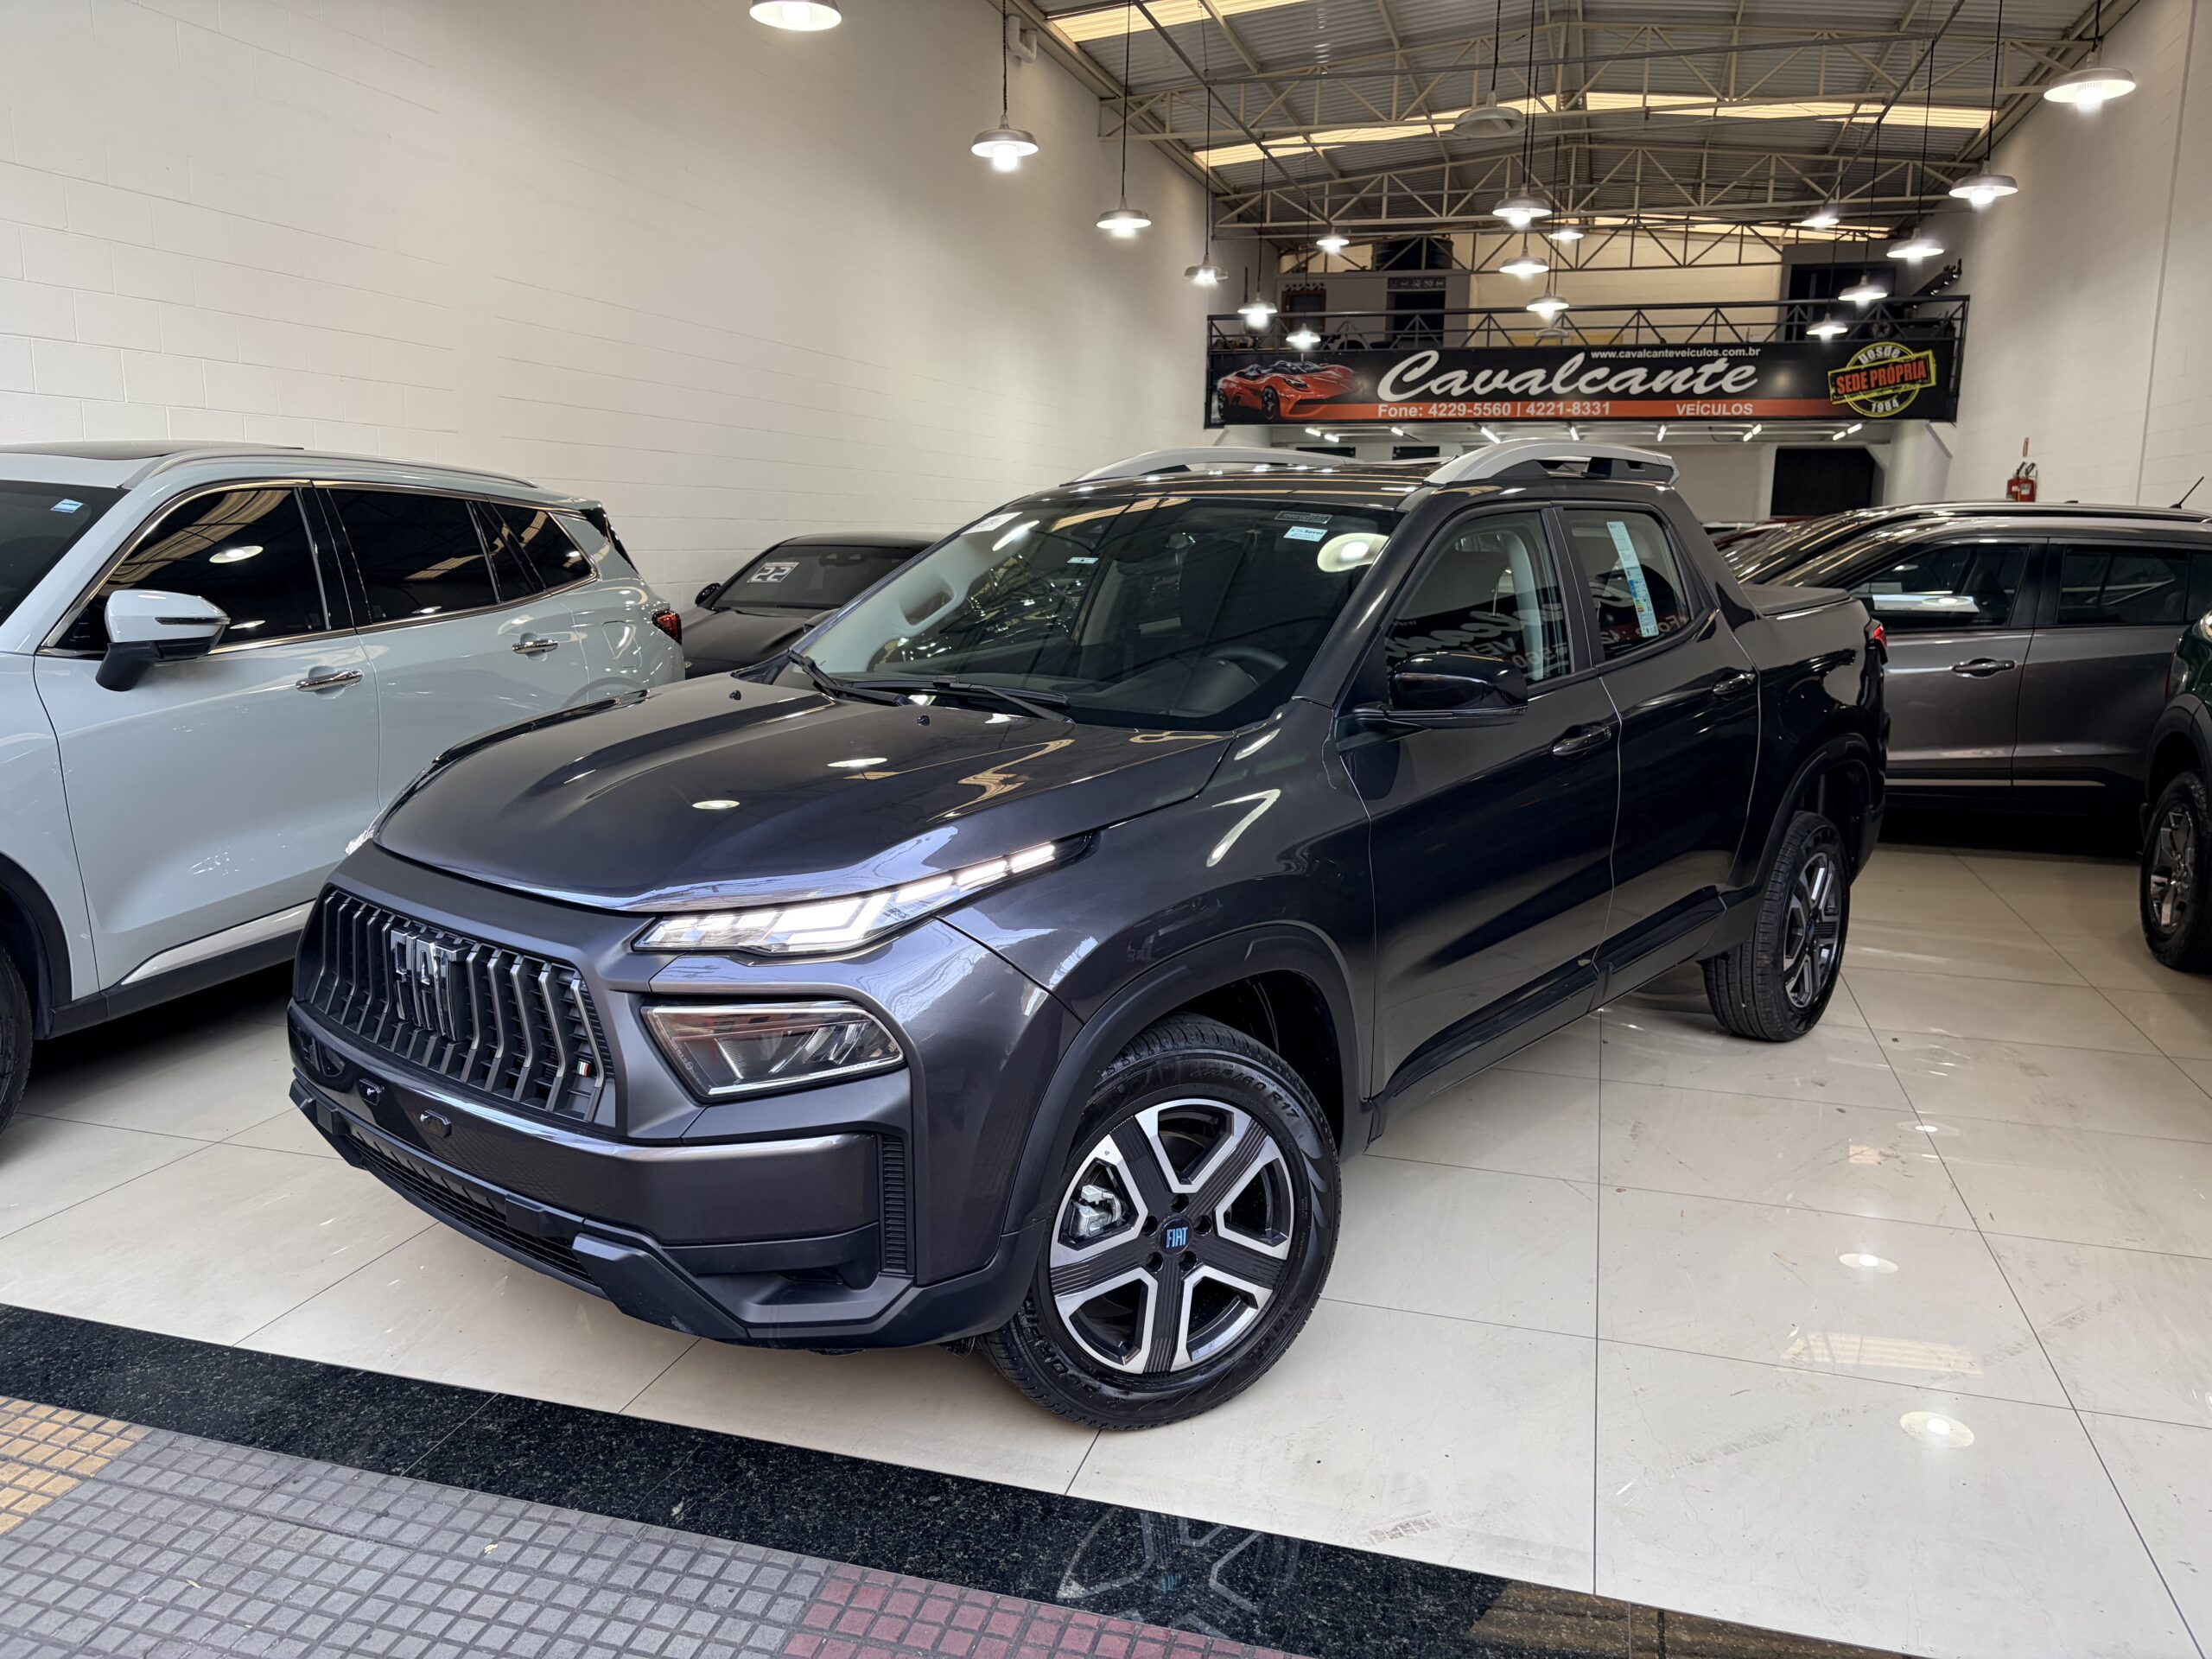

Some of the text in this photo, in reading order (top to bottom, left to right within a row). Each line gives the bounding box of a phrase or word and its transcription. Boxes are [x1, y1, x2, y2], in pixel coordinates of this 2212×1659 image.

[1591, 347, 1761, 359] www.cavalcanteveiculos.com.br
[1377, 350, 1758, 402] Cavalcante
[1836, 359, 1927, 395] SEDE PRÓPRIA
[1377, 404, 1424, 417] Fone:
[1427, 402, 1512, 416] 4229-5560
[1525, 401, 1611, 416] 4221-8331
[1676, 400, 1753, 416] VEÍCULOS
[1871, 399, 1900, 413] 1984
[1166, 1227, 1188, 1248] FIAT
